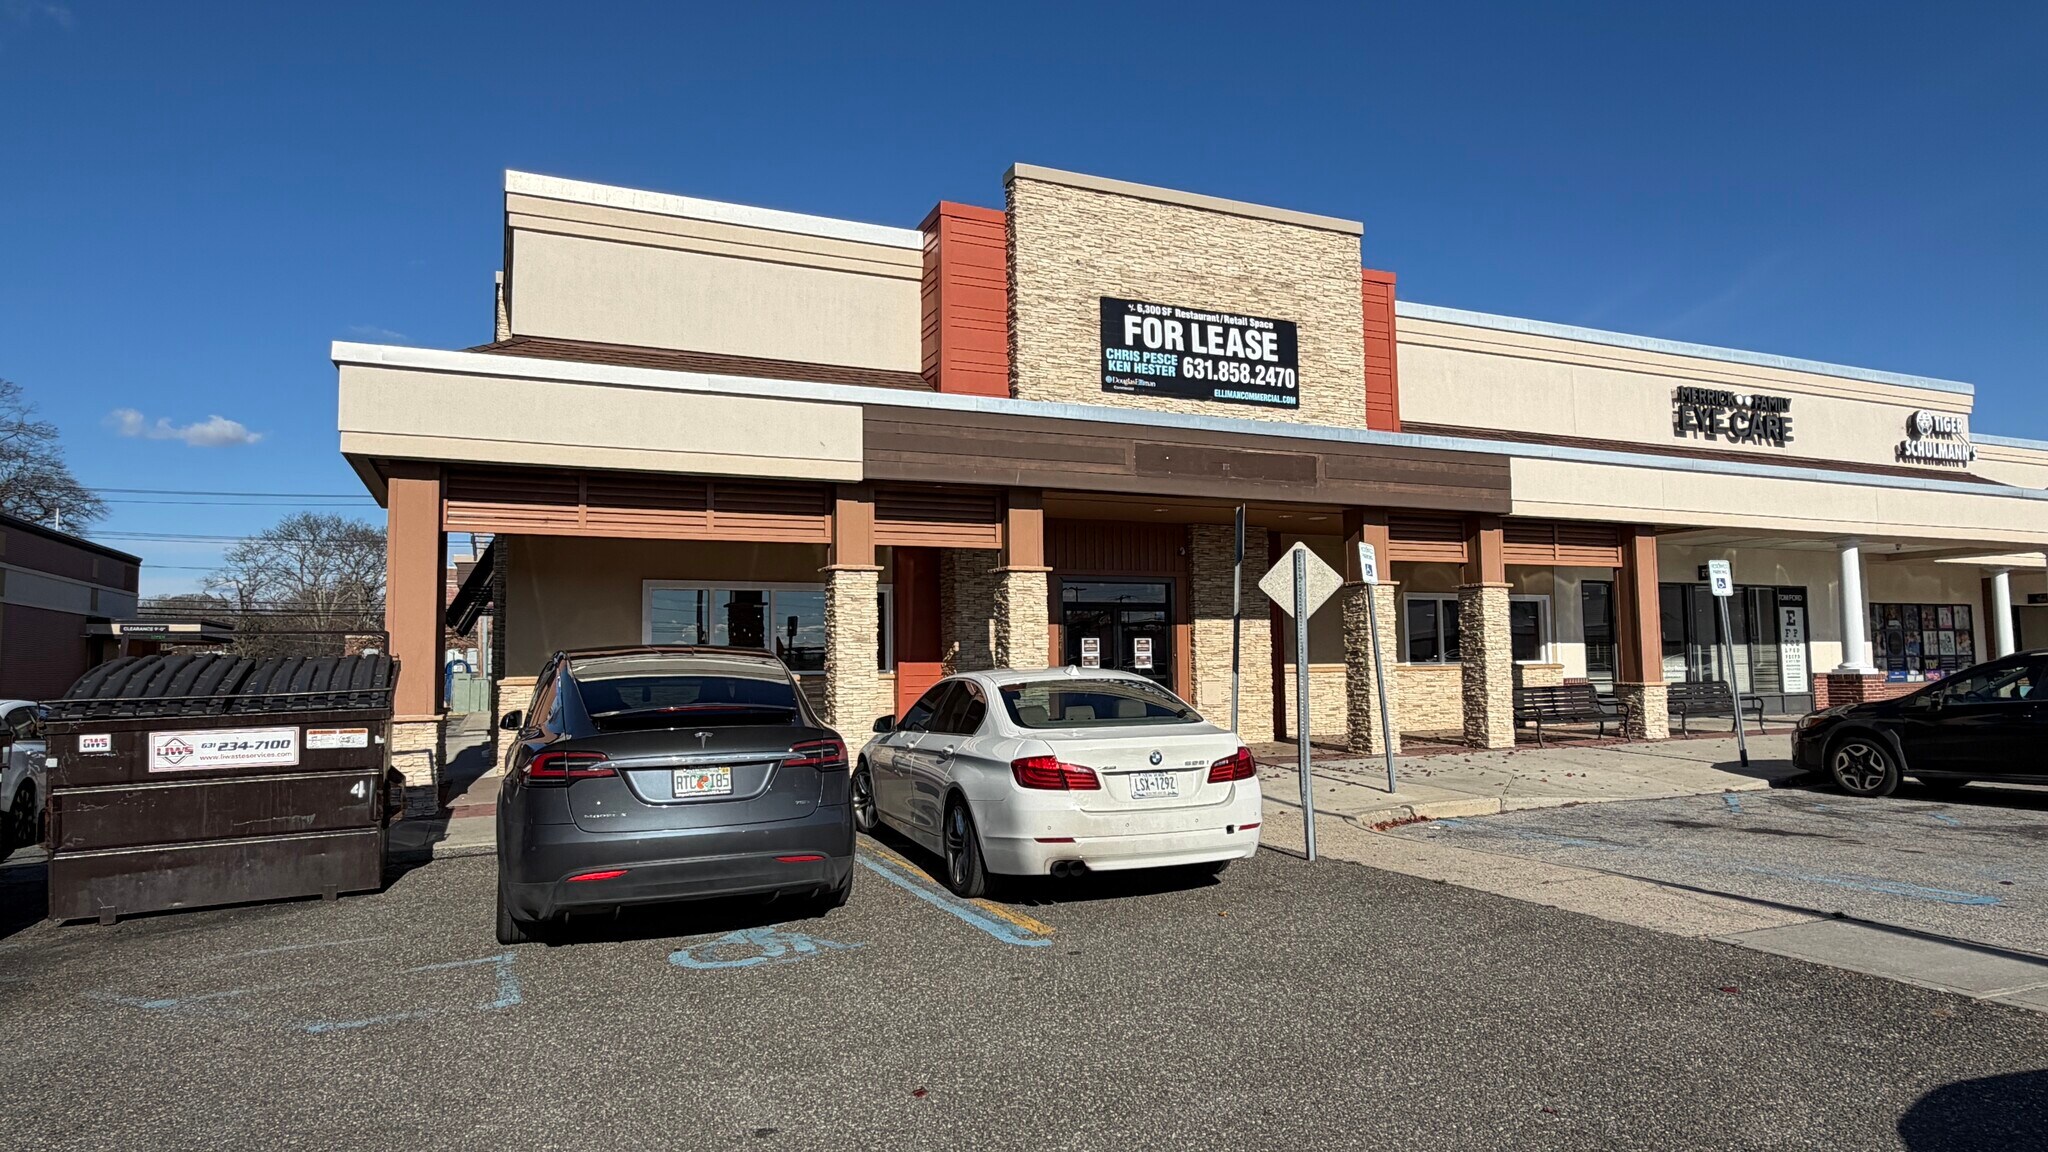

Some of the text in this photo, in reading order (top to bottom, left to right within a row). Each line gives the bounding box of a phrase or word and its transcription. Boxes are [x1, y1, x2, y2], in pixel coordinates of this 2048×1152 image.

[1137, 304, 1161, 315] 6,300
[1162, 306, 1172, 316] SF
[1175, 308, 1247, 326] Restaurant/Retail
[1249, 318, 1274, 330] Space
[1124, 314, 1279, 362] FOR LEASE
[1105, 348, 1178, 366] CHRIS PESCE
[1108, 360, 1176, 377] KEN HESTER
[1183, 357, 1295, 389] 631.858.2470
[1214, 389, 1296, 404] ELLIMANCOMMERCIAL.COM
[1679, 386, 1792, 412] MERRICK FAMILY
[1681, 405, 1794, 442] EYE CARE
[1934, 414, 1964, 434] TIGER
[1786, 610, 1796, 626] E
[218, 739, 291, 751] 234-7100
[200, 752, 292, 761] www.liwasteservices.com
[351, 780, 366, 798] 4
[676, 774, 696, 790] RTC
[1134, 776, 1175, 792] LSX 1292
